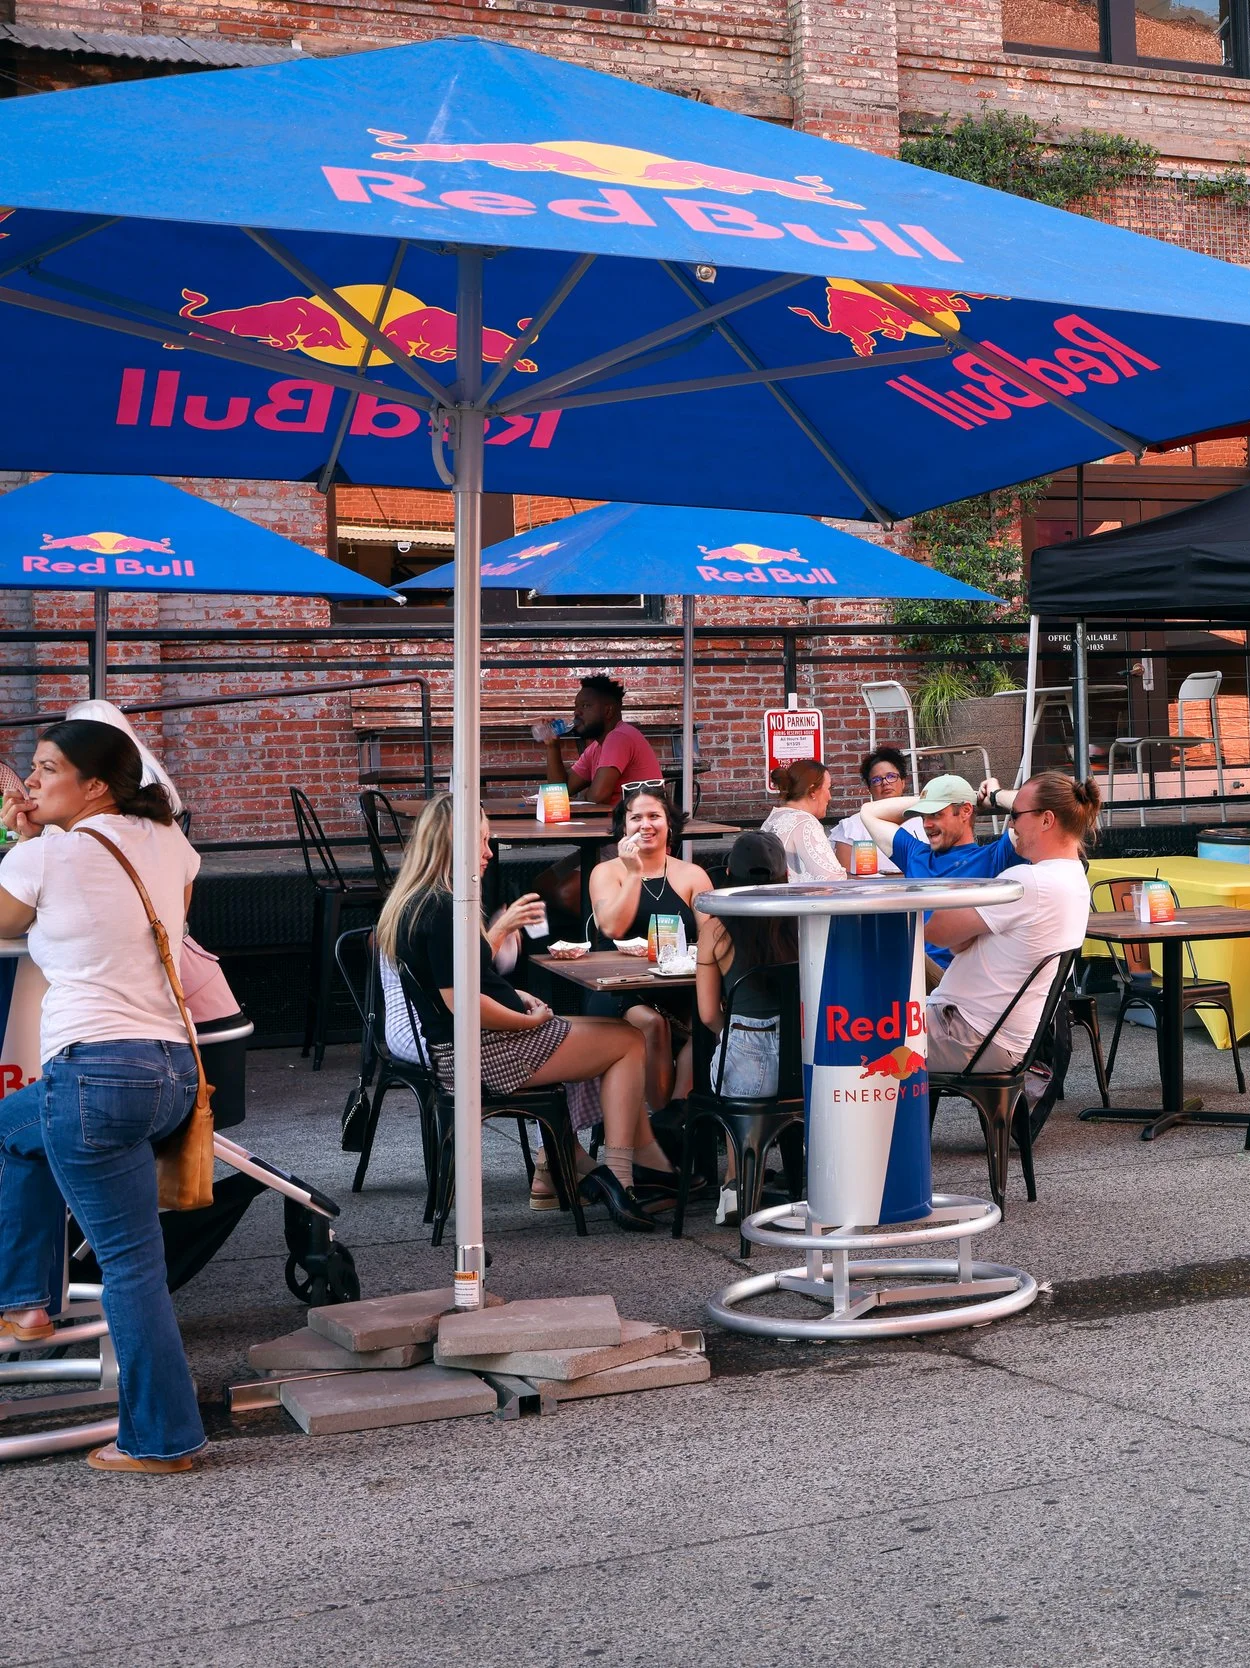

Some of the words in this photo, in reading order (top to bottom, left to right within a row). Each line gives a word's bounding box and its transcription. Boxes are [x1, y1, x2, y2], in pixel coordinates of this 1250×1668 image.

[320, 166, 657, 227] Red
[663, 196, 965, 263] Bull
[22, 555, 106, 574] Red
[115, 558, 195, 577] Bull
[696, 565, 769, 583] Red
[773, 567, 838, 585] Bull
[1048, 634, 1072, 642] OFFIC
[1086, 633, 1118, 641] AILABLE
[769, 714, 783, 730] NO
[786, 716, 816, 727] PARKING
[826, 1001, 901, 1042] Red
[833, 1085, 907, 1103] ENERGY
